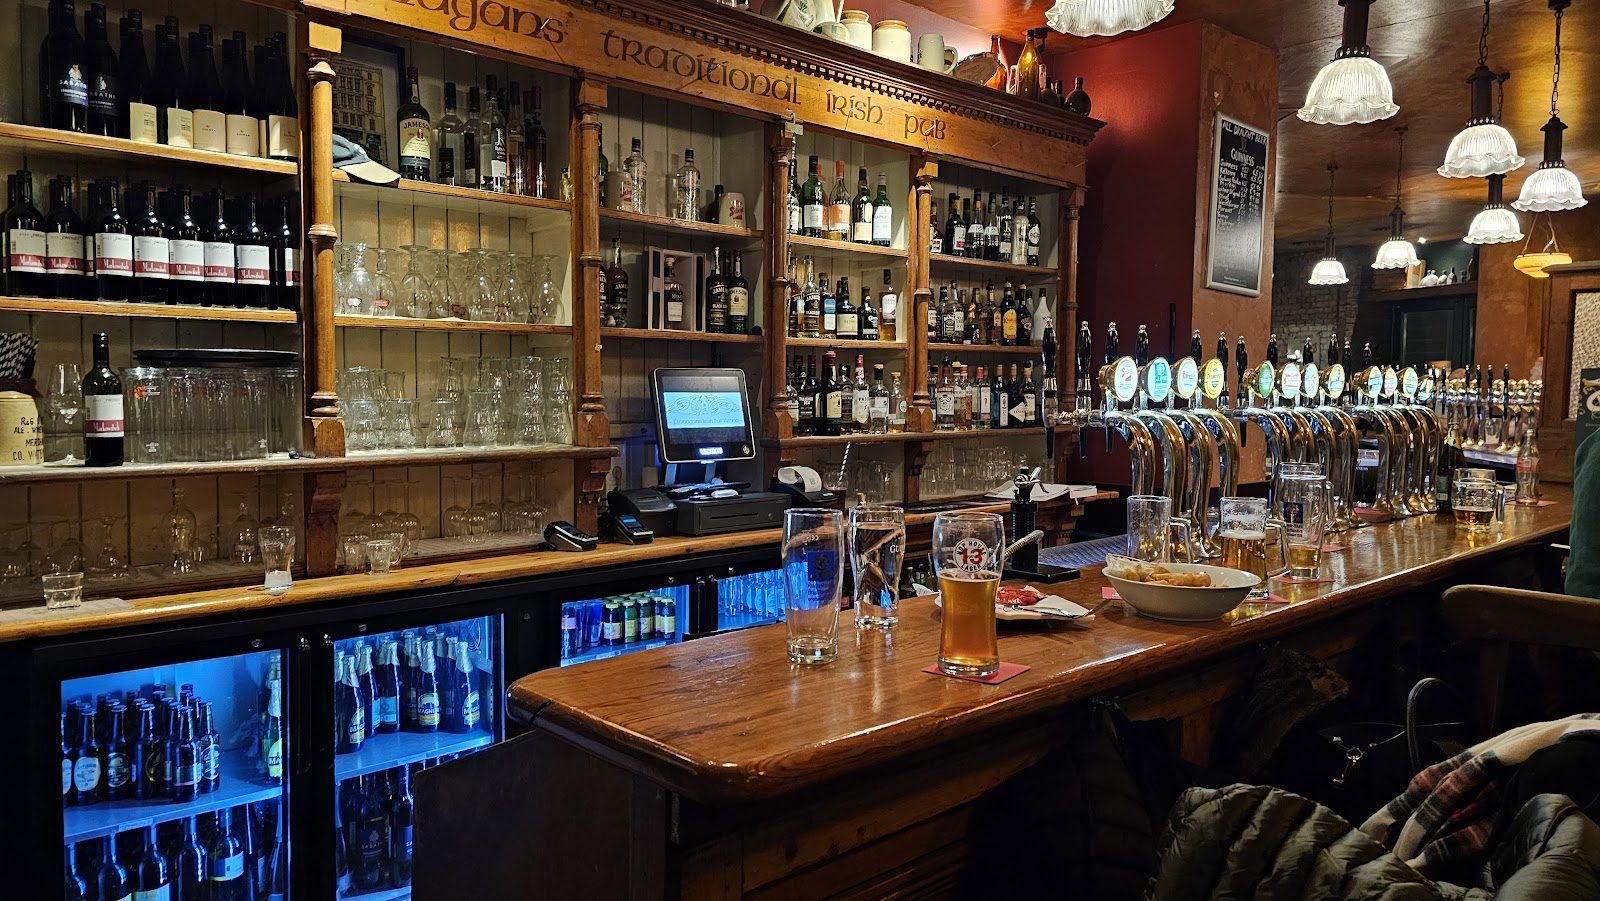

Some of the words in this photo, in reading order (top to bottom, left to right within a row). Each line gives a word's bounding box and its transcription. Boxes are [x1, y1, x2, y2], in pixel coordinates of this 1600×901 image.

[393, 0, 564, 44] gans
[1230, 147, 1255, 167] GUINNESS
[961, 548, 983, 565] 13
